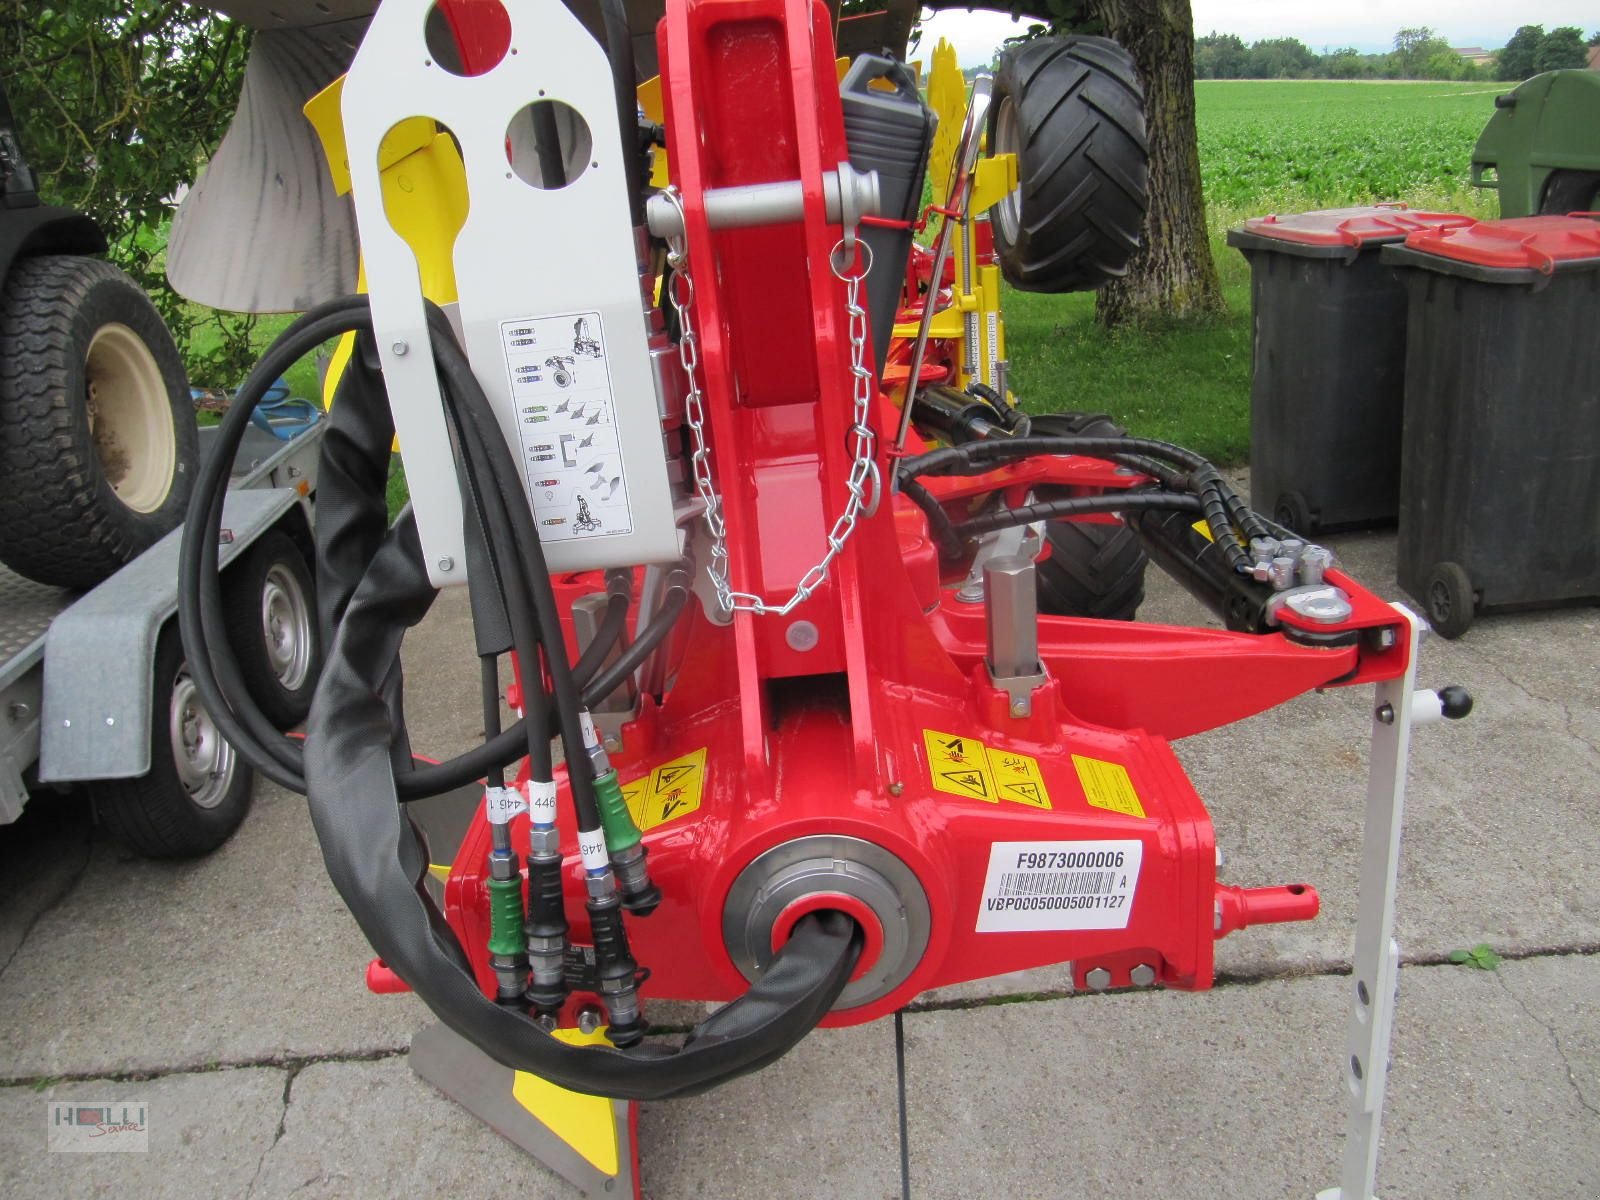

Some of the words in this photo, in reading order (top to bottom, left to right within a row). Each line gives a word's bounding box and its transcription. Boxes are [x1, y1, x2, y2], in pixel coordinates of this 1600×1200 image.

[534, 797, 556, 808] 446
[582, 843, 602, 855] 446
[1017, 852, 1124, 868] F9873000006
[1119, 875, 1127, 888] A
[987, 896, 1125, 911] VBP00050005001127
